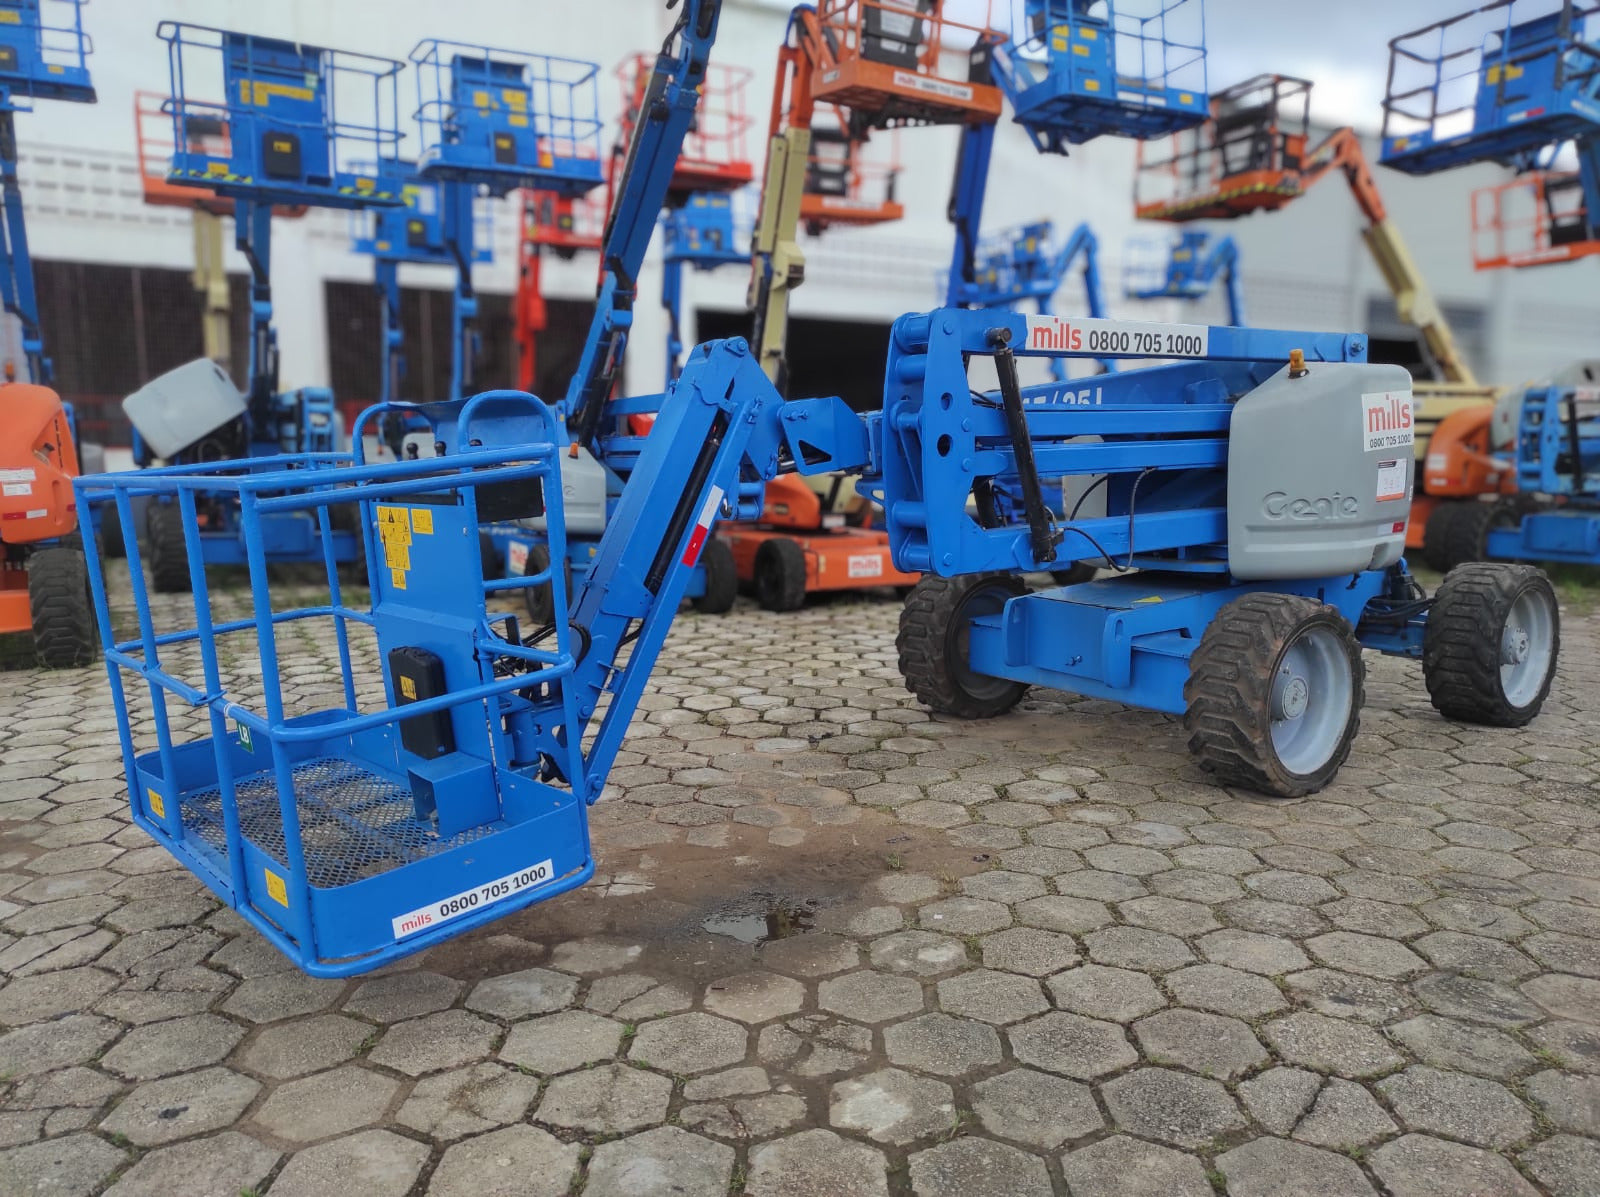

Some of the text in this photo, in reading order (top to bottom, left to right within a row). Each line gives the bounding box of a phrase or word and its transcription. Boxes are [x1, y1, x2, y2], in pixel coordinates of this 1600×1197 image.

[1033, 317, 1202, 355] mills 0800 705 1000
[1368, 393, 1411, 432] mills
[401, 866, 547, 932] mills 0800 705 1000
